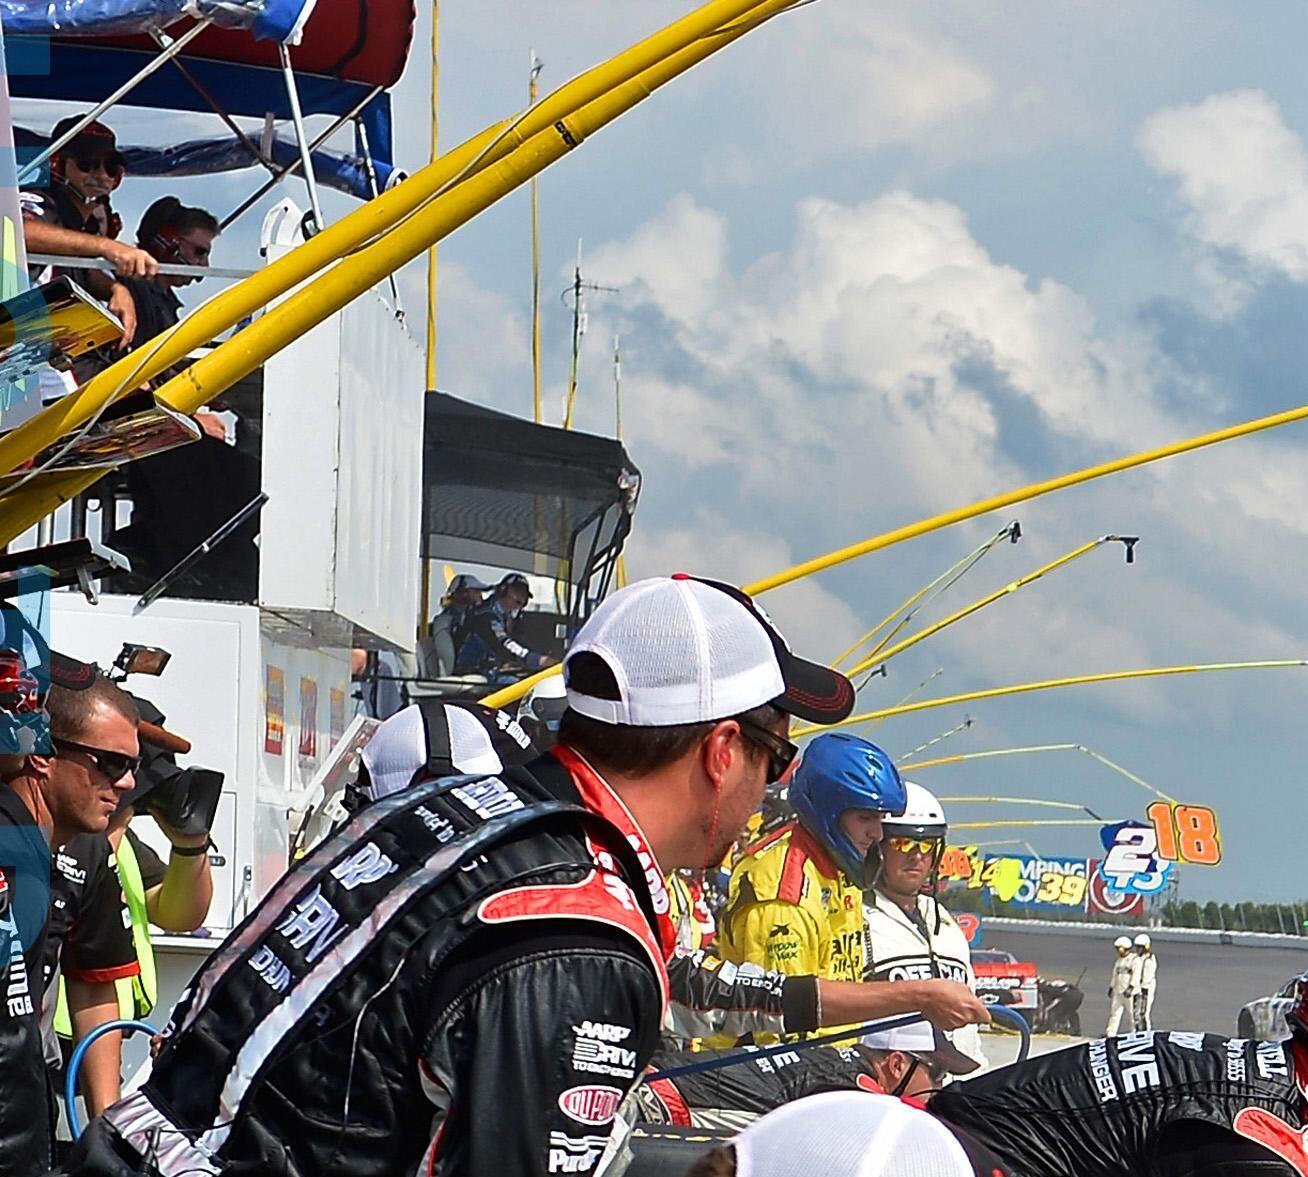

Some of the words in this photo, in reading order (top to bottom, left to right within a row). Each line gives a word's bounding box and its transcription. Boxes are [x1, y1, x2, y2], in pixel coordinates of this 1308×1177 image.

[1103, 827, 1157, 872] 2
[1146, 801, 1222, 866] 18
[1037, 873, 1088, 905] 39
[573, 1021, 631, 1043] AARP
[573, 1037, 637, 1068] DRIV
